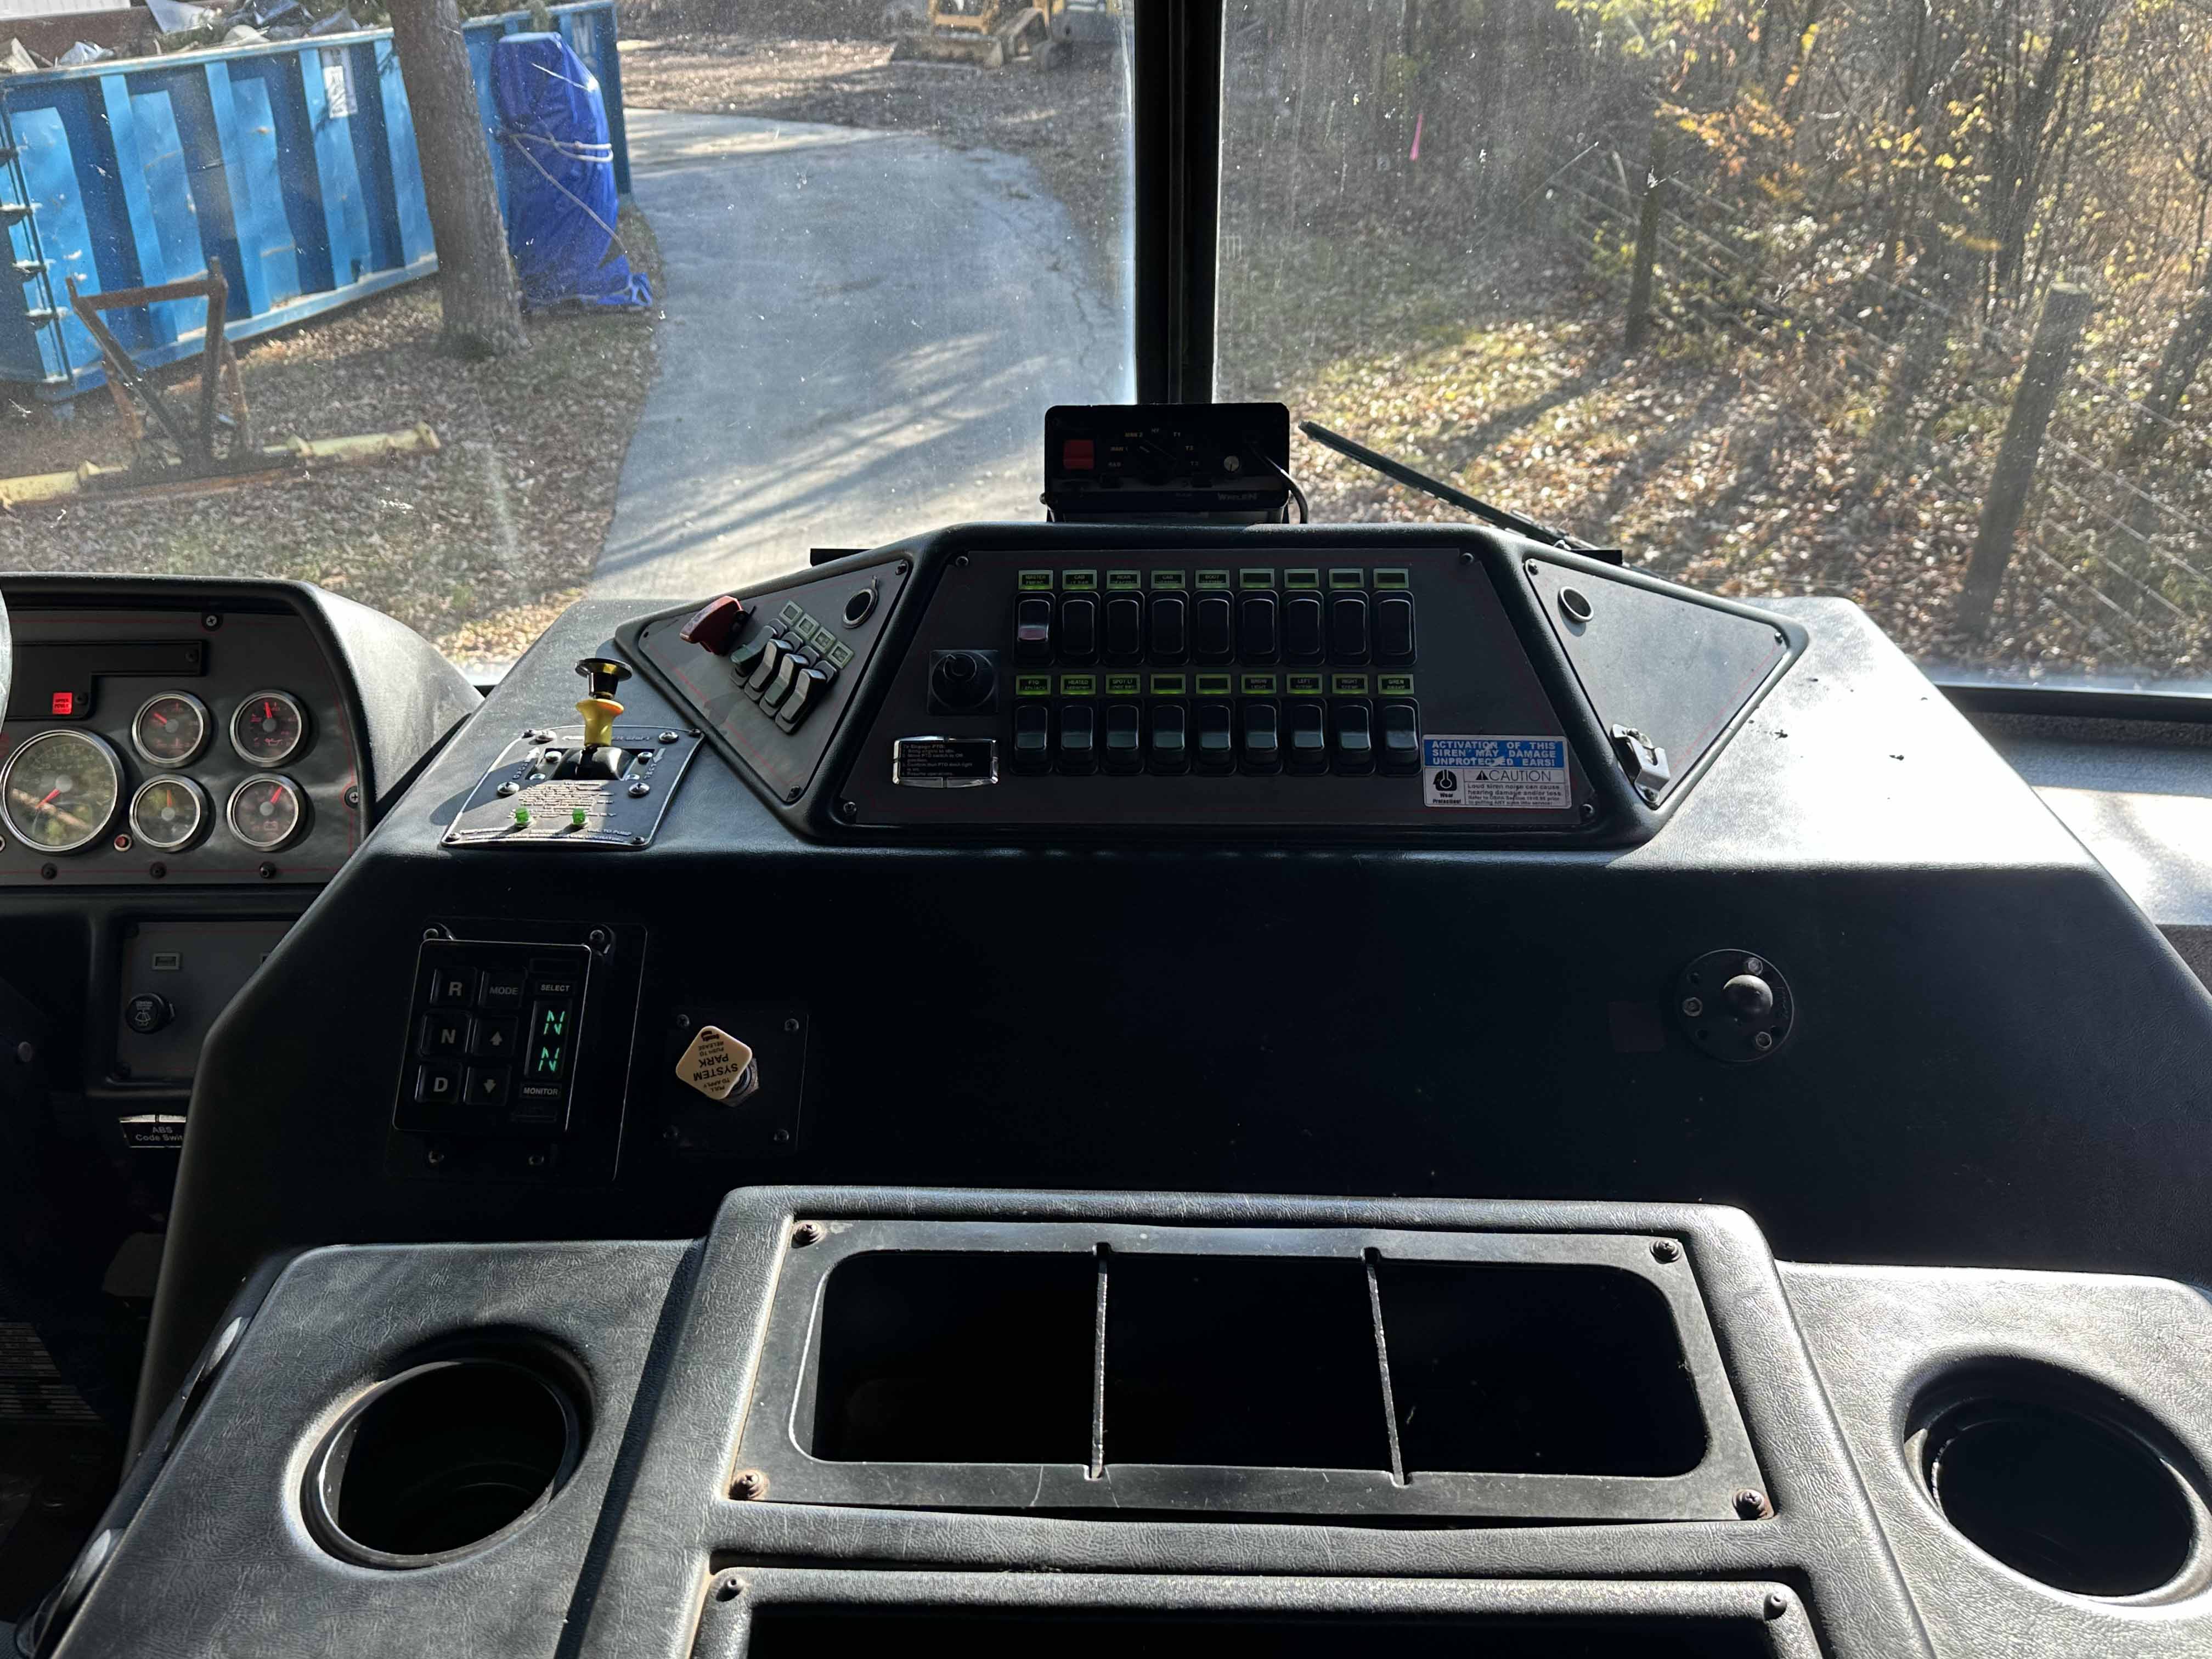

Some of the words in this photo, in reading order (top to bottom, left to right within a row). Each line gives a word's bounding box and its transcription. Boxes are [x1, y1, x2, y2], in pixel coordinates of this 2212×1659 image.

[1432, 741, 1498, 749] ACTIVATION
[1506, 741, 1521, 750] OF
[1530, 742, 1556, 750] THIS
[1432, 749, 1466, 757] SIREN
[1509, 750, 1556, 758] DAMAGE
[1523, 758, 1555, 766] EARS!
[1489, 770, 1551, 782] CAUTION
[448, 981, 463, 997] R
[489, 986, 518, 995] MODE
[540, 984, 571, 992] SELECT
[543, 1009, 566, 1036] N
[440, 1028, 457, 1045] N
[698, 1041, 724, 1051] RELEASE
[709, 1047, 725, 1056] PUSH
[538, 1046, 561, 1071] N
[698, 1053, 729, 1068] PARK
[693, 1063, 738, 1081] SYSTEM
[433, 1076, 449, 1093] D
[522, 1086, 559, 1096] MONITOR
[136, 1133, 161, 1142] Code
[162, 1133, 184, 1142] Swit
